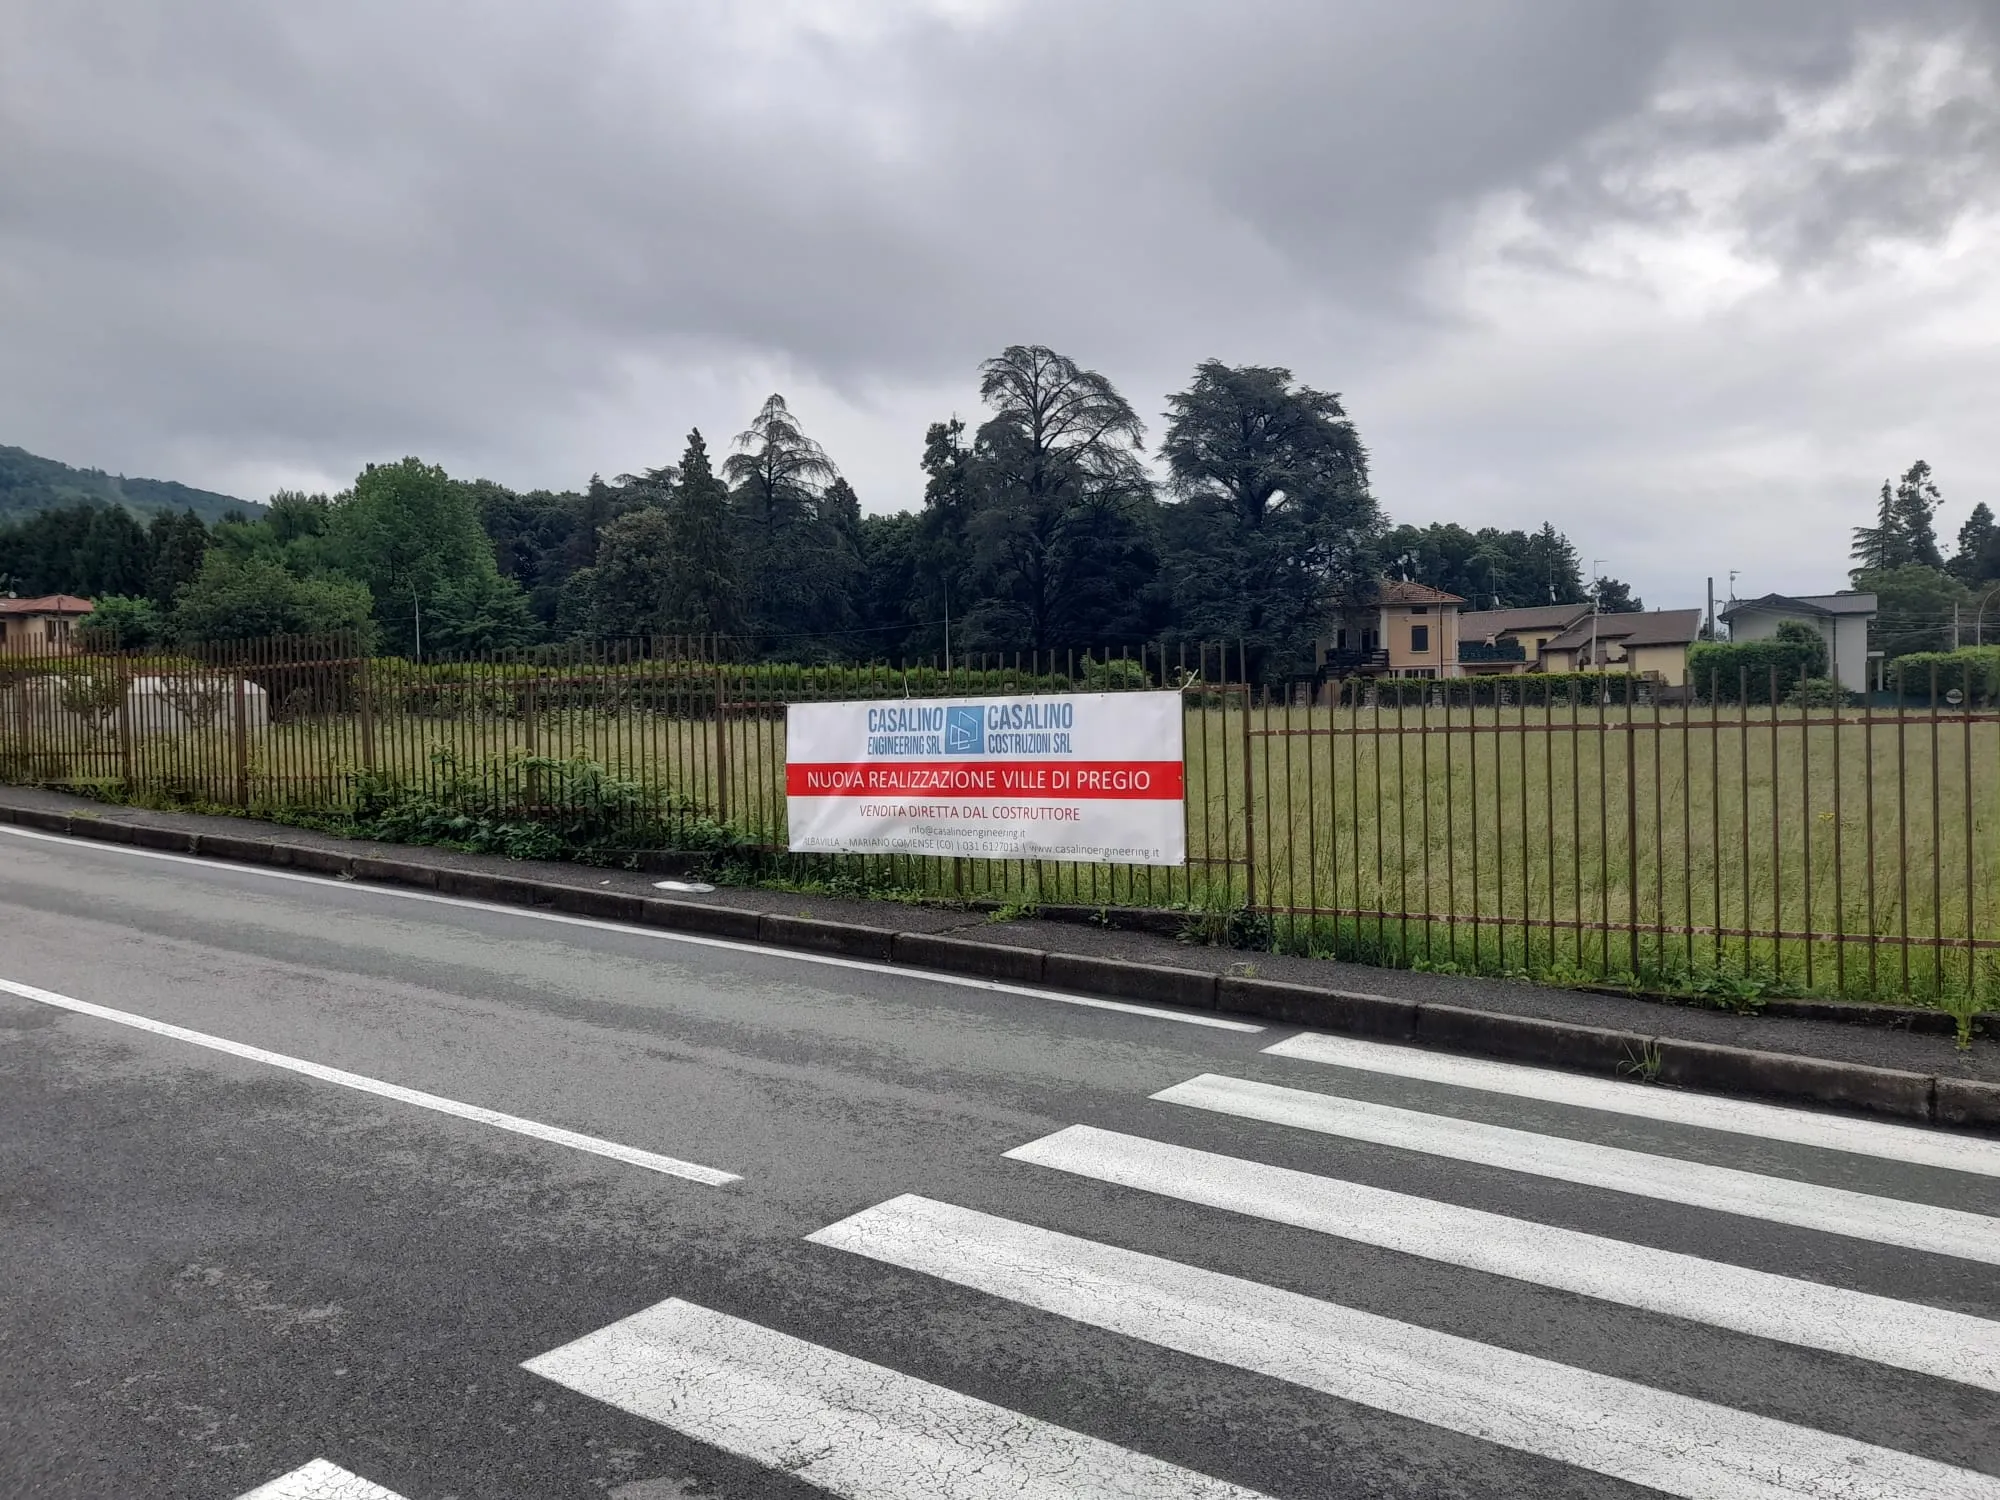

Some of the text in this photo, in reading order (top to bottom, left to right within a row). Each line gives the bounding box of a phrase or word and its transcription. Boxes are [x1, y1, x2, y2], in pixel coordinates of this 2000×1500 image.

[867, 706, 944, 733] CASALINO
[987, 702, 1073, 731] CASALINO
[867, 735, 942, 756] ENGINEERING SRL
[988, 732, 1073, 754] COSTRUZIONI SRL
[807, 770, 1151, 791] NUOVA REALIZZAZIONE VILLE DI PREGIO
[859, 804, 1081, 821] VENDITA DIRETTA DAL COSTRUTTORE
[909, 824, 1026, 840] info@casalinoengineering.it
[849, 838, 890, 848] MARIANO
[892, 839, 935, 849] COMENSE
[936, 839, 954, 851] (CO)
[962, 841, 980, 852] 031
